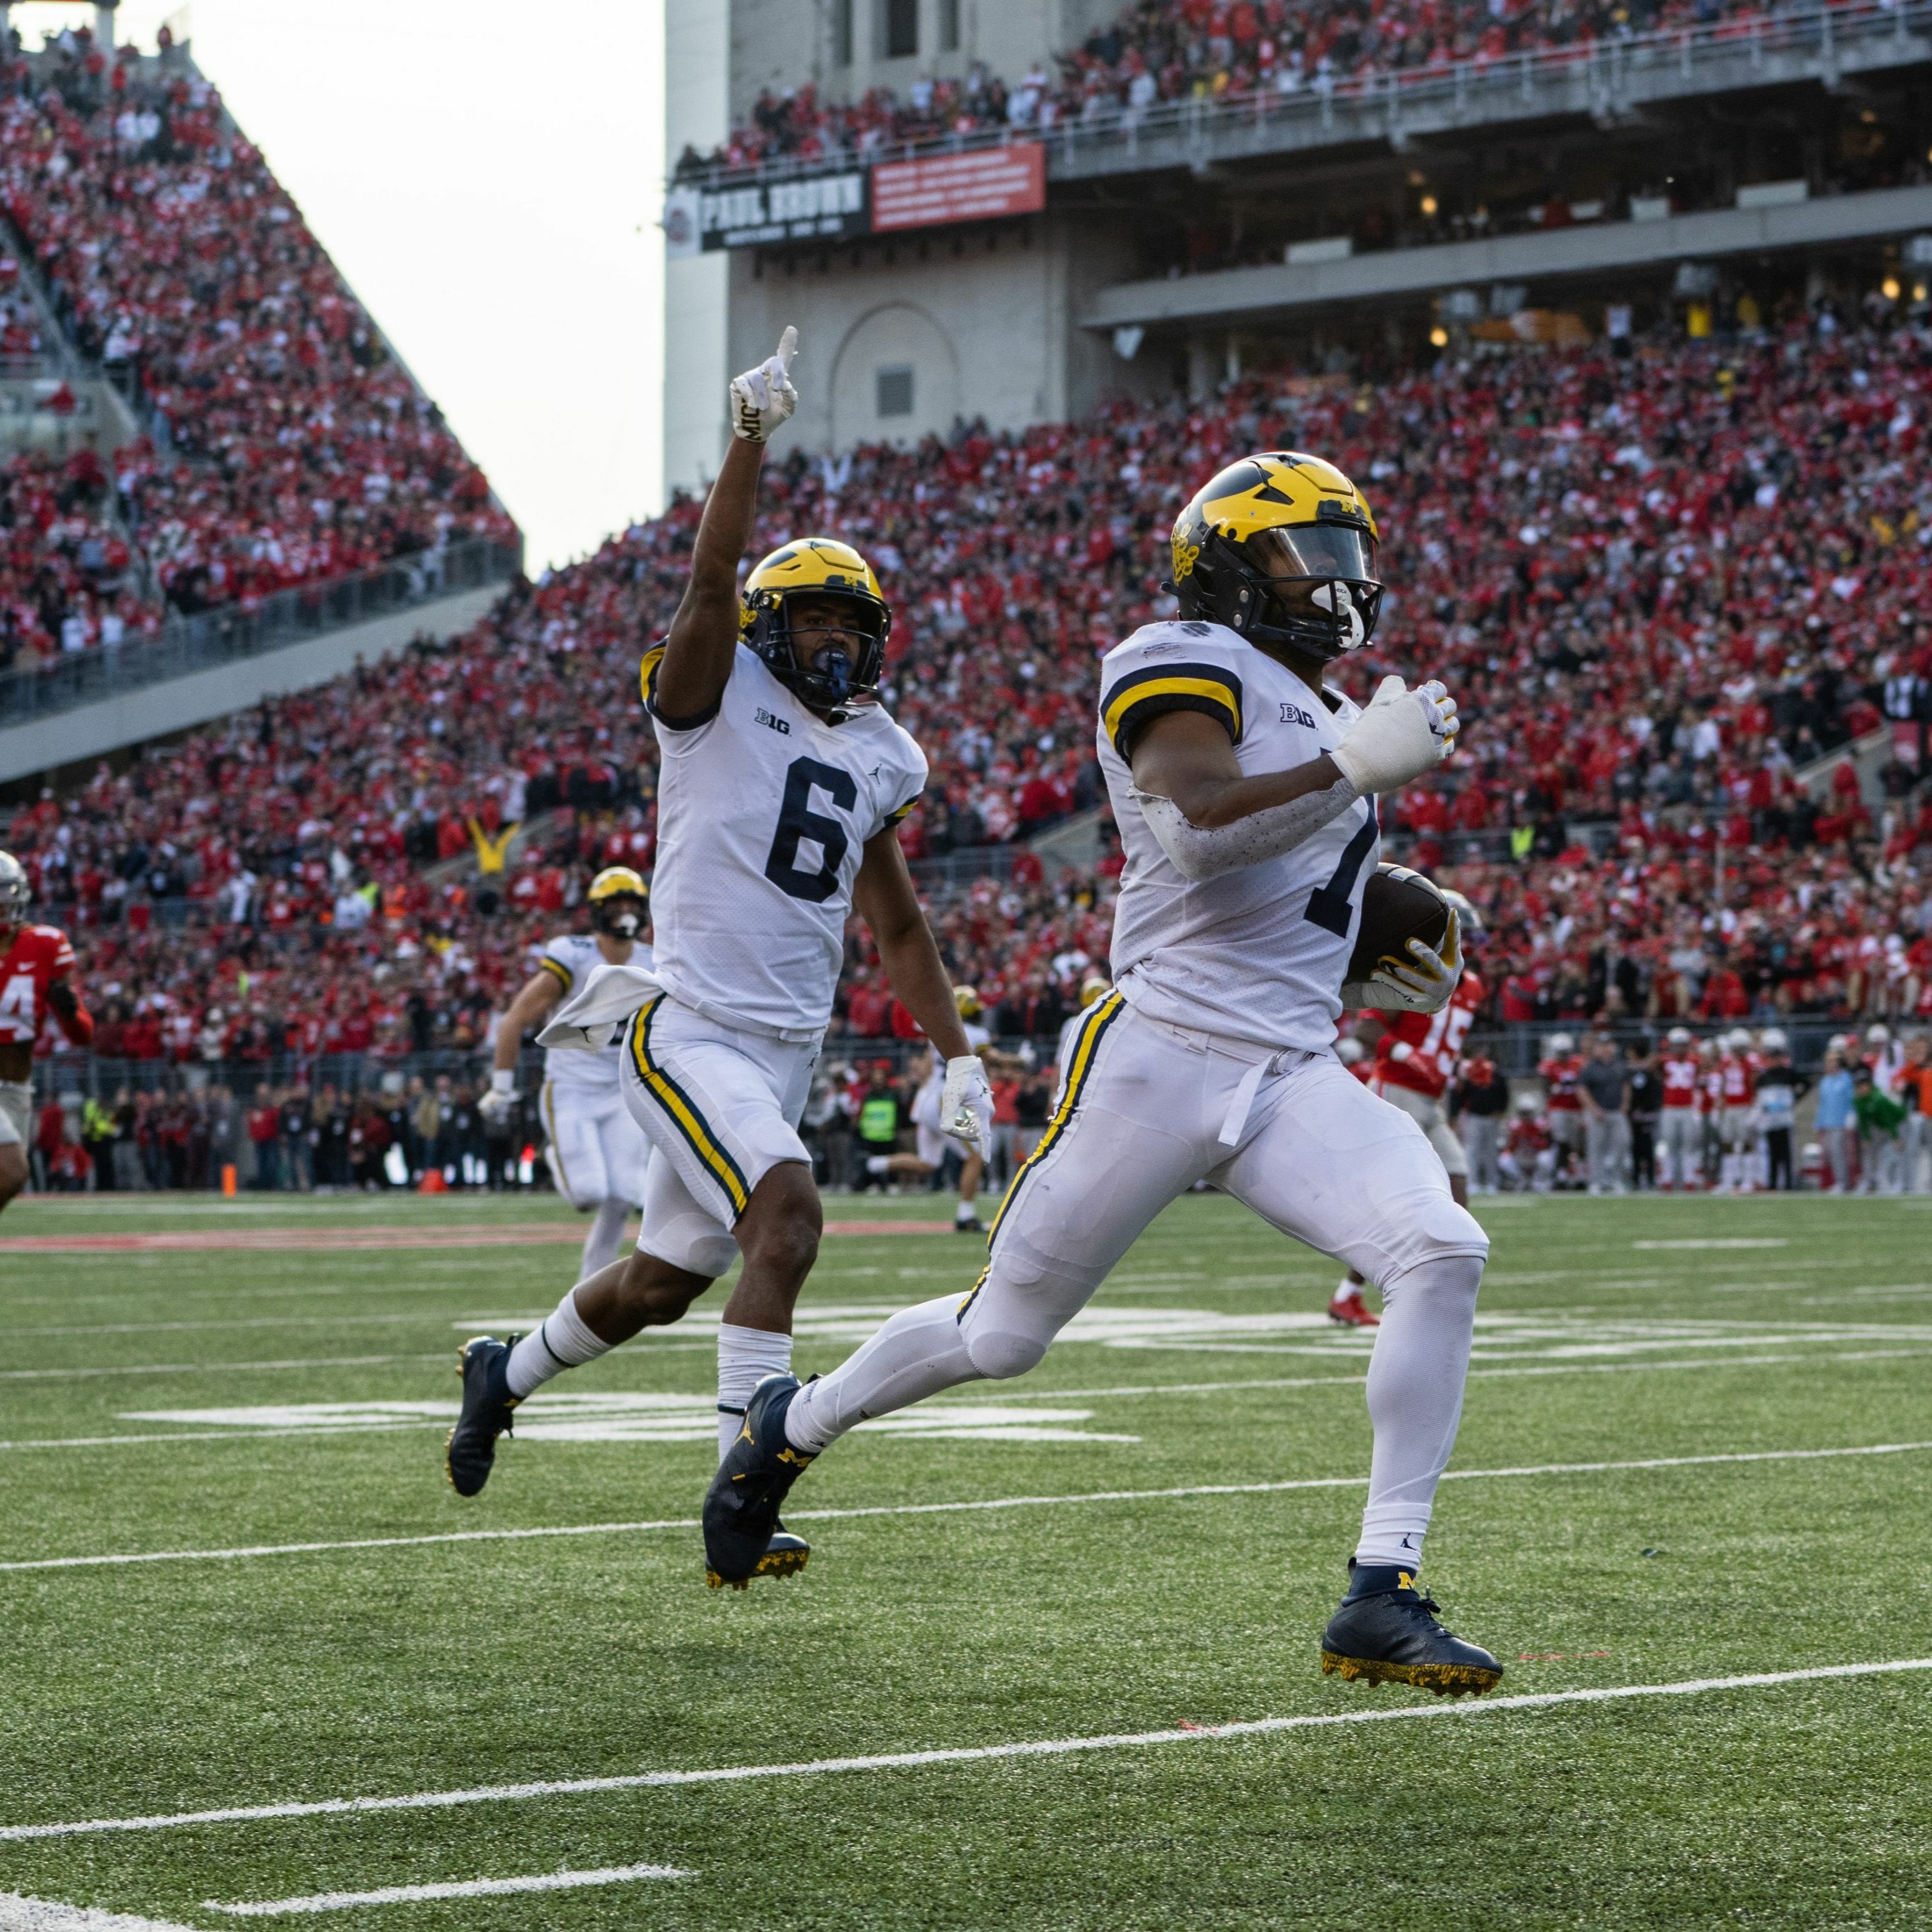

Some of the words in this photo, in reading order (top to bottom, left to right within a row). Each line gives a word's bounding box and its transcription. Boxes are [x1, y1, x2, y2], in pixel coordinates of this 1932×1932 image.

[741, 398, 761, 440] MIC
[764, 755, 858, 904] 6
[1303, 747, 1379, 939] 7
